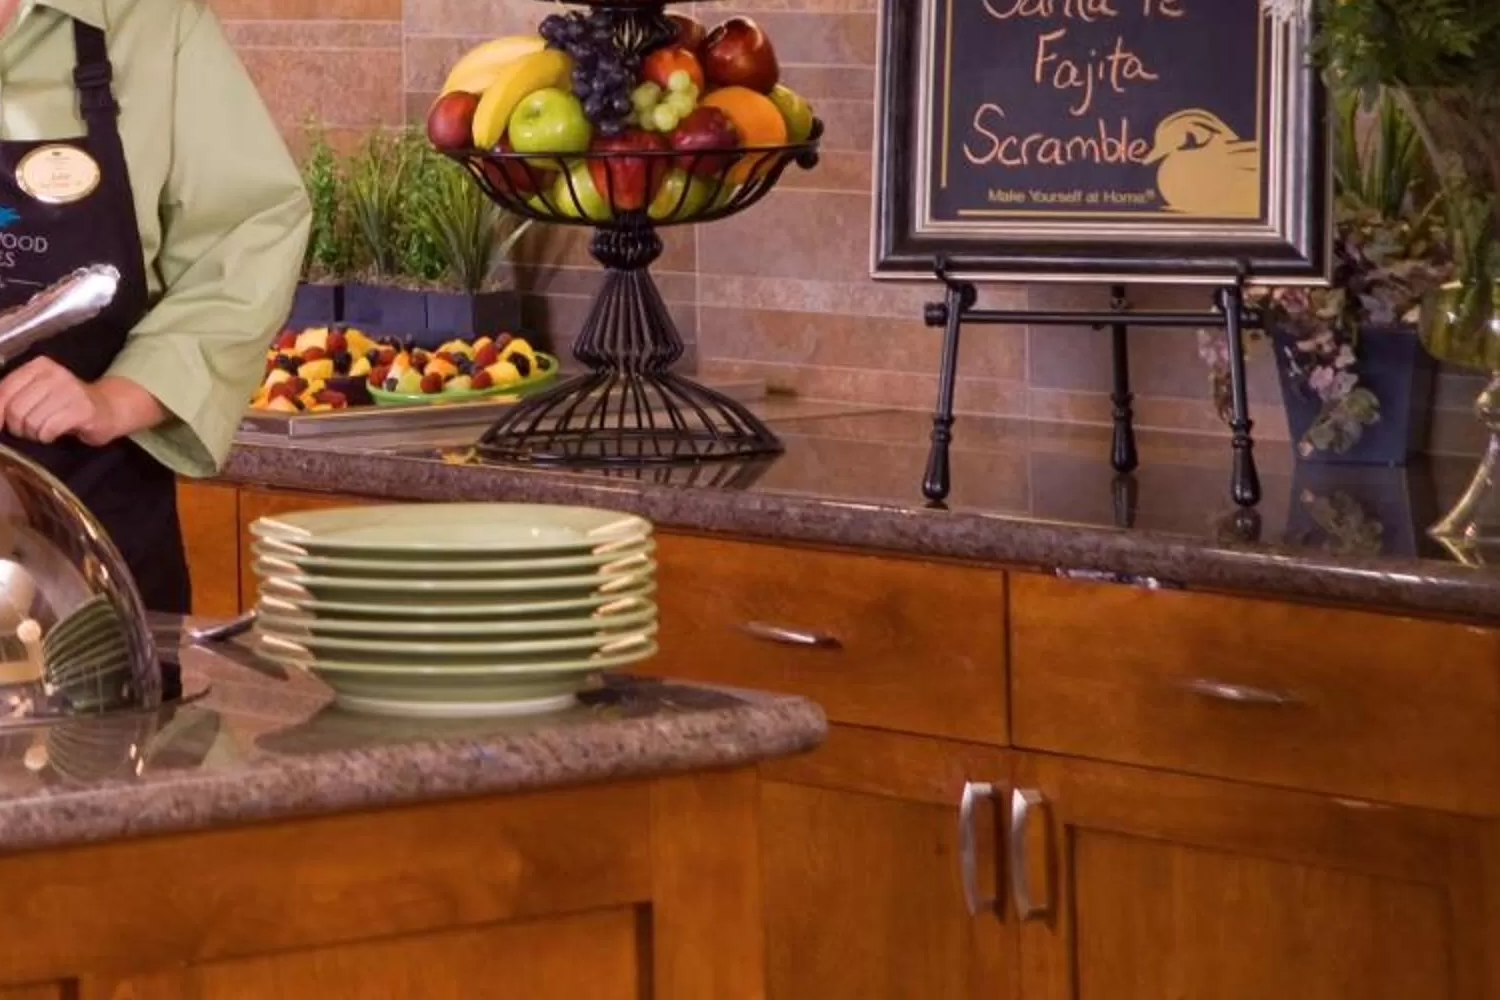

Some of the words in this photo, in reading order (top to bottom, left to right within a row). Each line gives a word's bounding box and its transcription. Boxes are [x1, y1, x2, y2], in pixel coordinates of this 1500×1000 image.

[1034, 28, 1160, 117] Fajita
[963, 103, 1152, 166] Scramble
[987, 189, 1025, 203] Make
[1028, 189, 1083, 204] Yourself
[1086, 190, 1100, 203] at
